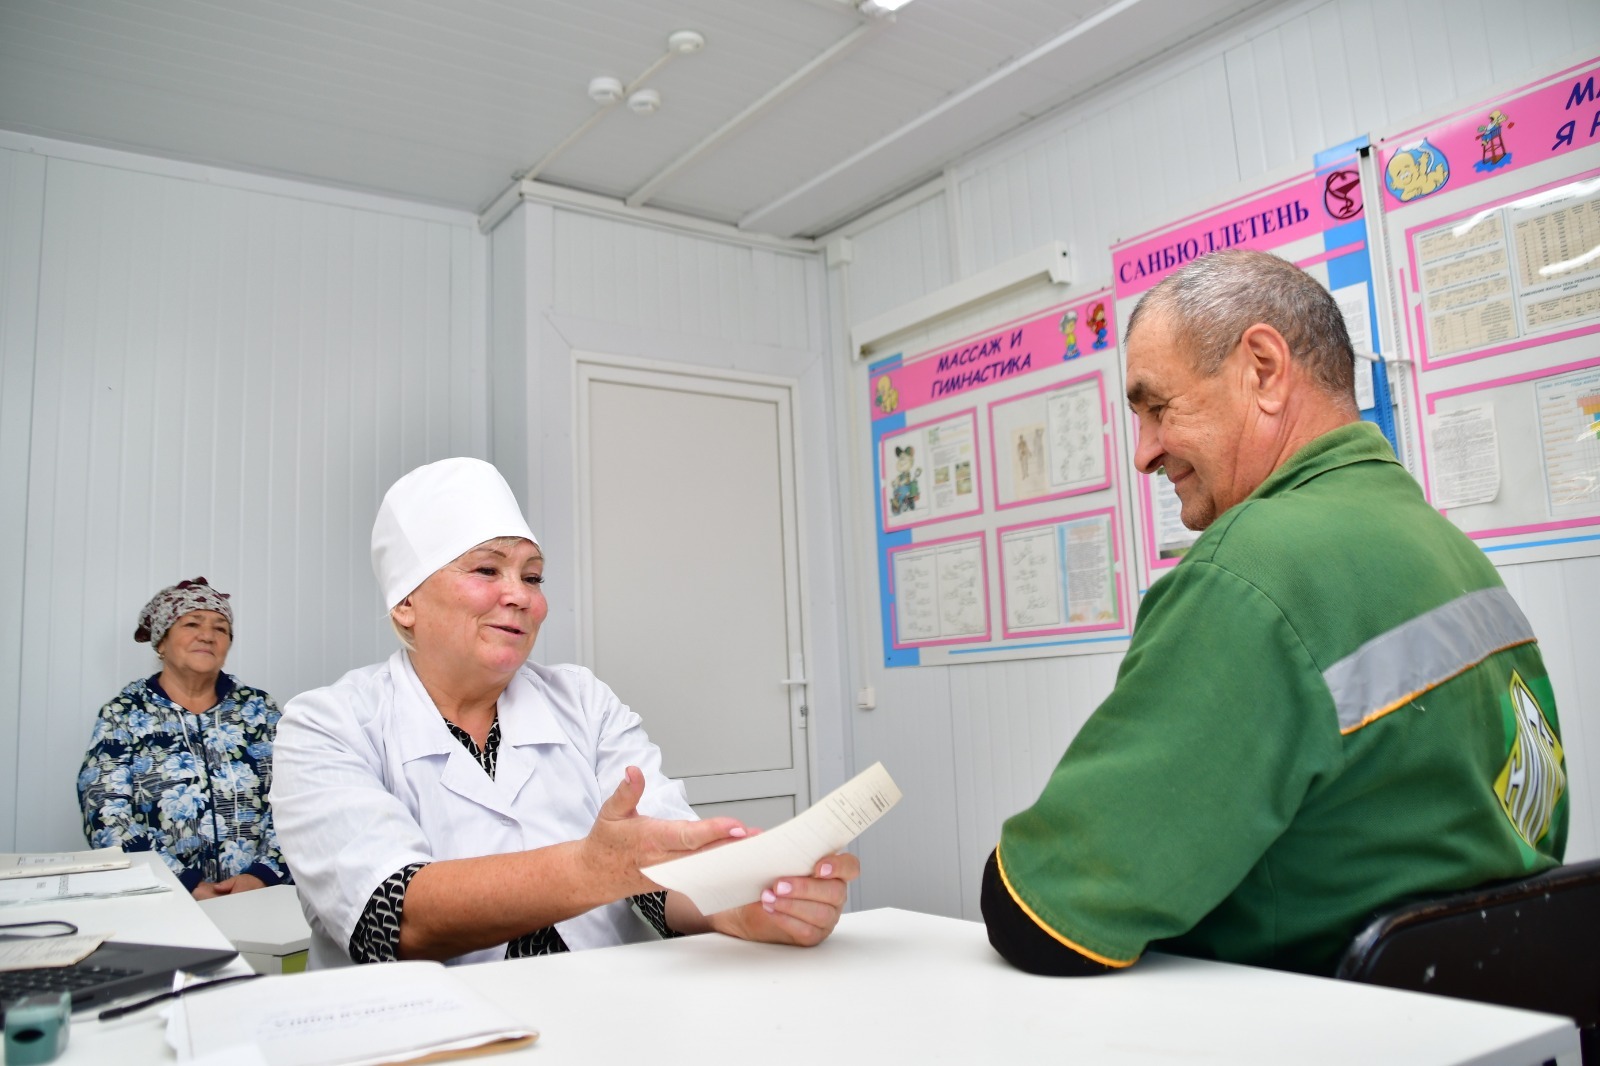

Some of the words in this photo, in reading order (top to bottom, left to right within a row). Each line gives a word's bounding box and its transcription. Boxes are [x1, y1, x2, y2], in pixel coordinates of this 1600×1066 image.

[1565, 76, 1600, 110] М
[1551, 120, 1576, 151] Я
[1119, 200, 1310, 284] САНБЮЛЛЕТЕНЬ
[936, 336, 1003, 375] МАССАЖ
[1009, 328, 1023, 350] И
[931, 352, 1032, 399] ГИМНАСТИКА
